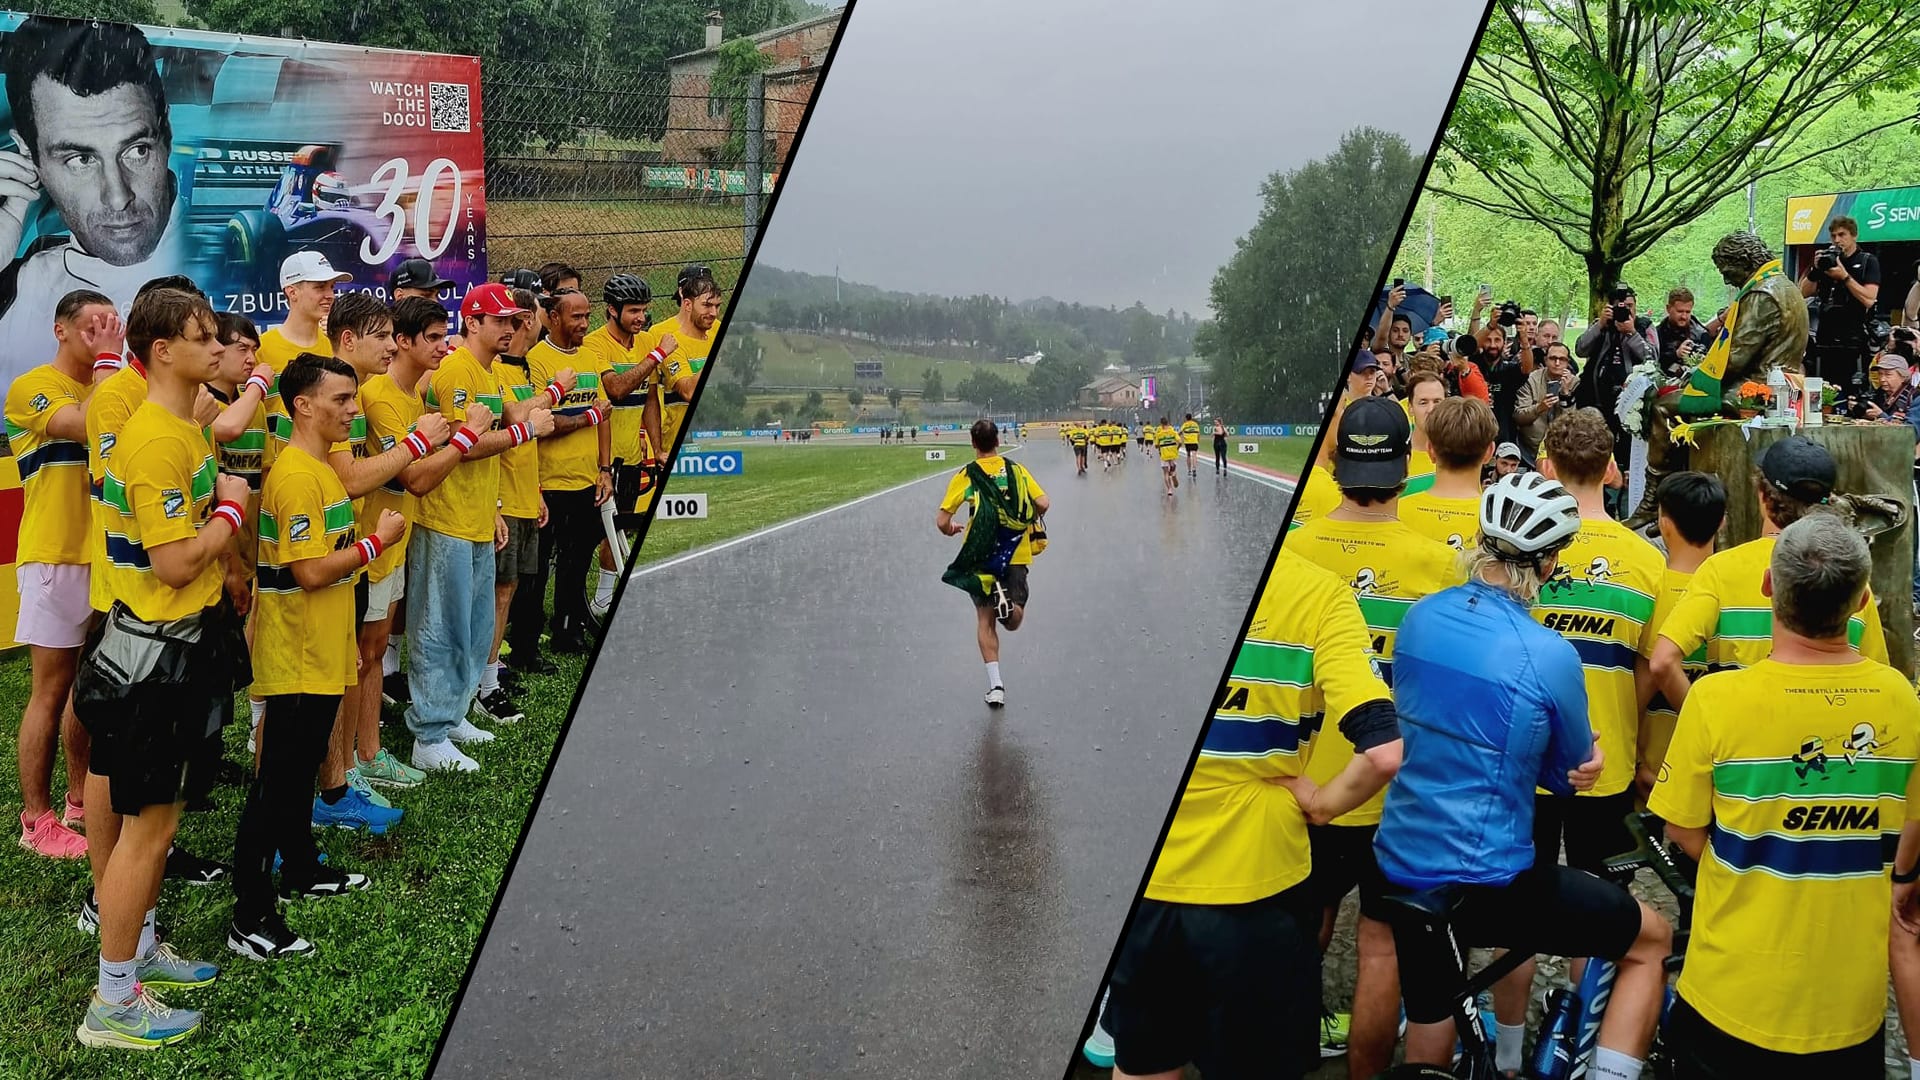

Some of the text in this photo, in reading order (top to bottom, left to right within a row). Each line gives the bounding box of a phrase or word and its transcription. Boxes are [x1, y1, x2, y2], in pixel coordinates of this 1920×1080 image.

[370, 81, 424, 97] WATCH
[396, 98, 425, 112] THE
[383, 112, 426, 127] DOCU
[228, 150, 296, 162] RUSSE
[232, 165, 285, 175] ATHL
[359, 157, 461, 266] 30
[1889, 206, 1920, 222] SEN
[466, 193, 475, 260] YEARS
[209, 291, 291, 314] LZBUR
[1245, 425, 1284, 436] aramco
[1295, 425, 1320, 436] aram
[671, 455, 737, 474] mco
[665, 499, 698, 517] 100
[1543, 612, 1615, 636] SENNA
[1782, 805, 1879, 831] SENNA
